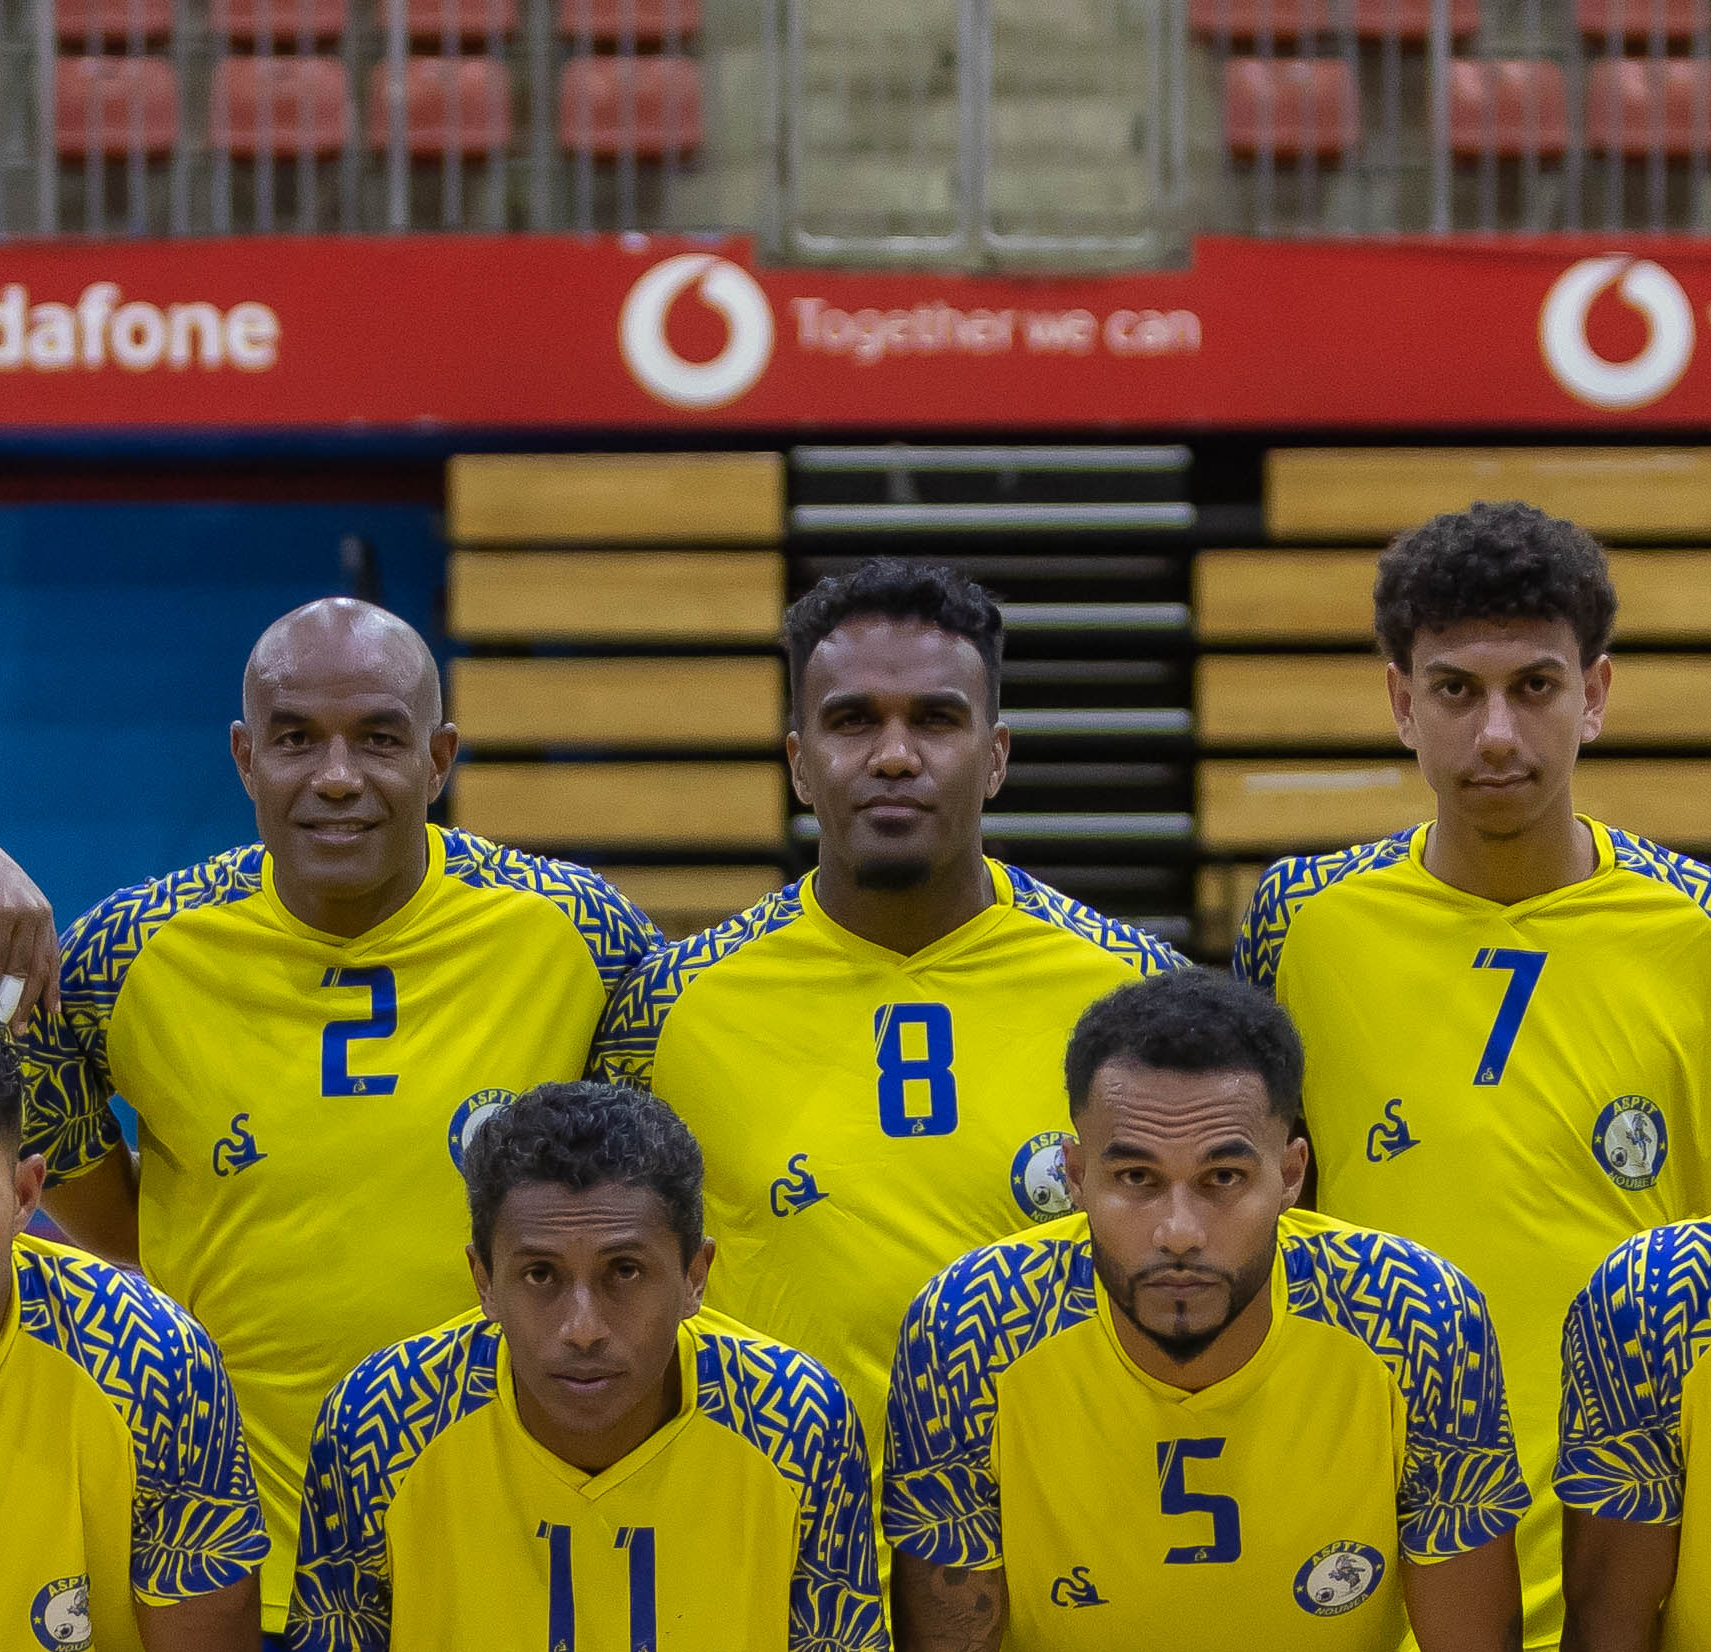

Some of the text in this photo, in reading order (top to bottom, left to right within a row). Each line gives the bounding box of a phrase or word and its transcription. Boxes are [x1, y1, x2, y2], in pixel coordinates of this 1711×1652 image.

[793, 295, 1201, 362] Together we can
[320, 965, 400, 1098] 2
[874, 1002, 959, 1138] 8
[1472, 947, 1549, 1087] 7
[1613, 1096, 1658, 1116] ASPTT
[1156, 1437, 1242, 1564] 5
[1312, 1540, 1367, 1567] ASPTT
